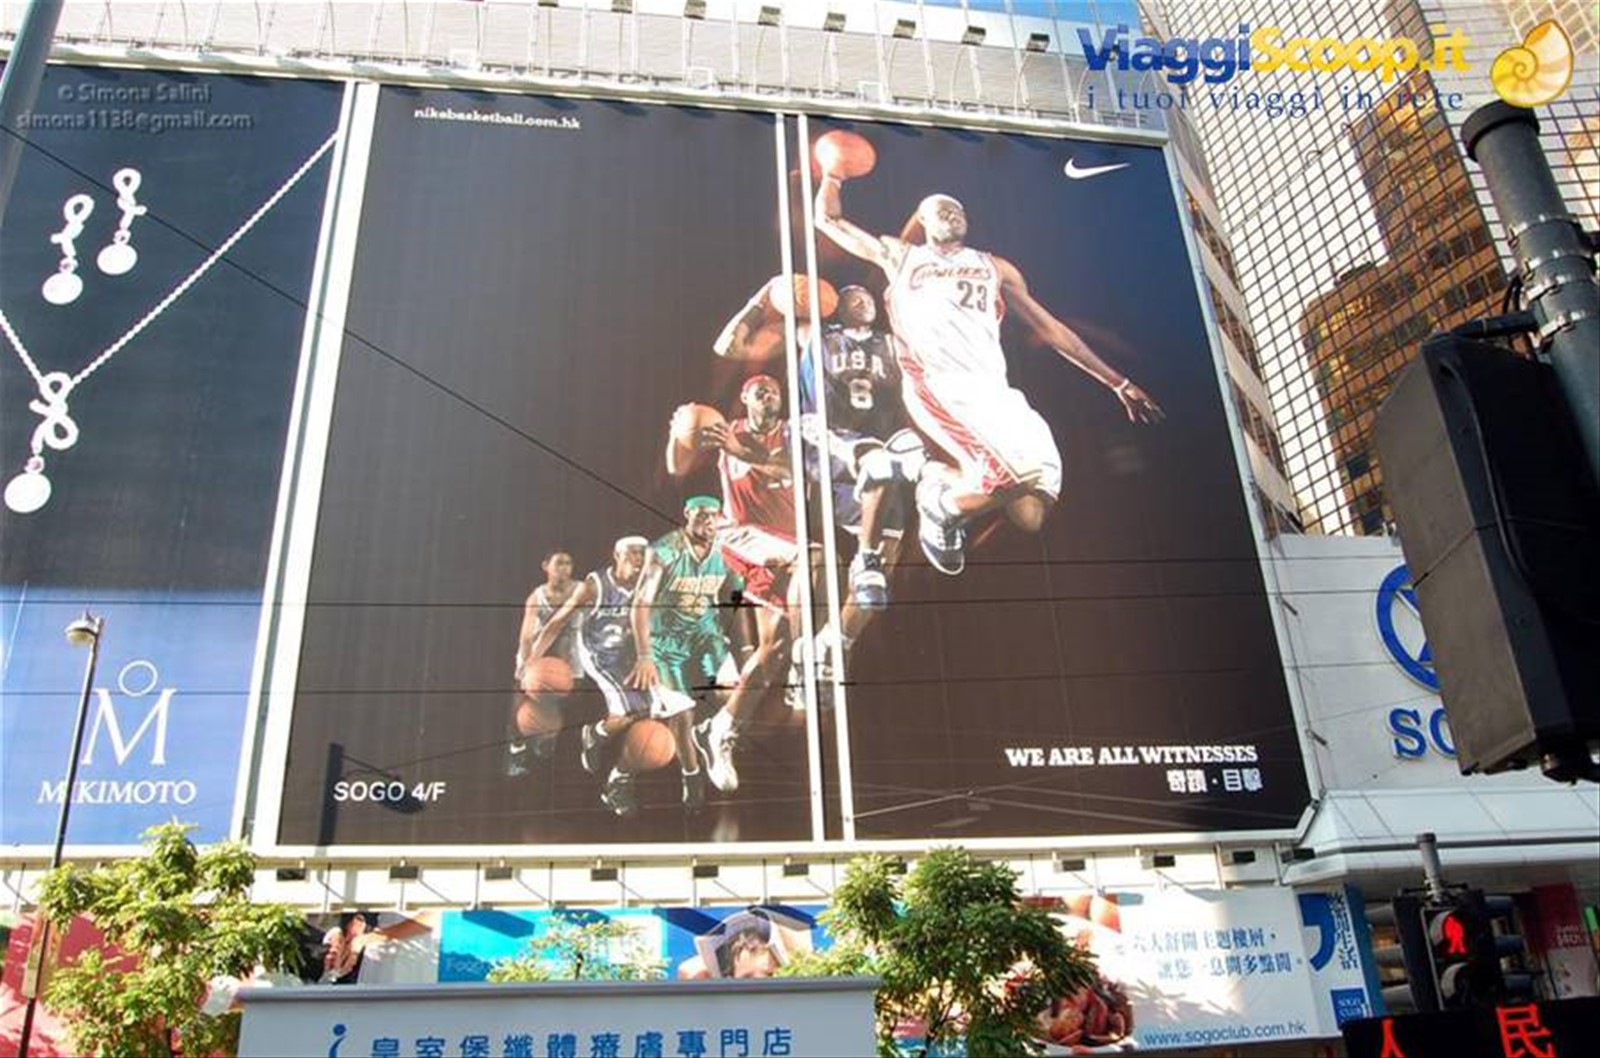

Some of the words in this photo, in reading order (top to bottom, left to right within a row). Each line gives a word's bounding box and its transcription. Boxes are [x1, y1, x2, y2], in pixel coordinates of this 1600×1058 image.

[414, 107, 581, 129] nikebasketball.com.hk
[957, 280, 987, 313] 23
[1005, 748, 1045, 767] WE
[1048, 748, 1095, 767] ARE
[1098, 747, 1139, 765] ALL
[1139, 745, 1259, 764] WITNESSES
[37, 779, 197, 805] MKIMOTO
[333, 780, 406, 802] SOGO
[411, 781, 446, 802] 4/F
[1143, 1020, 1308, 1046] www.sogoclub.com.hk
